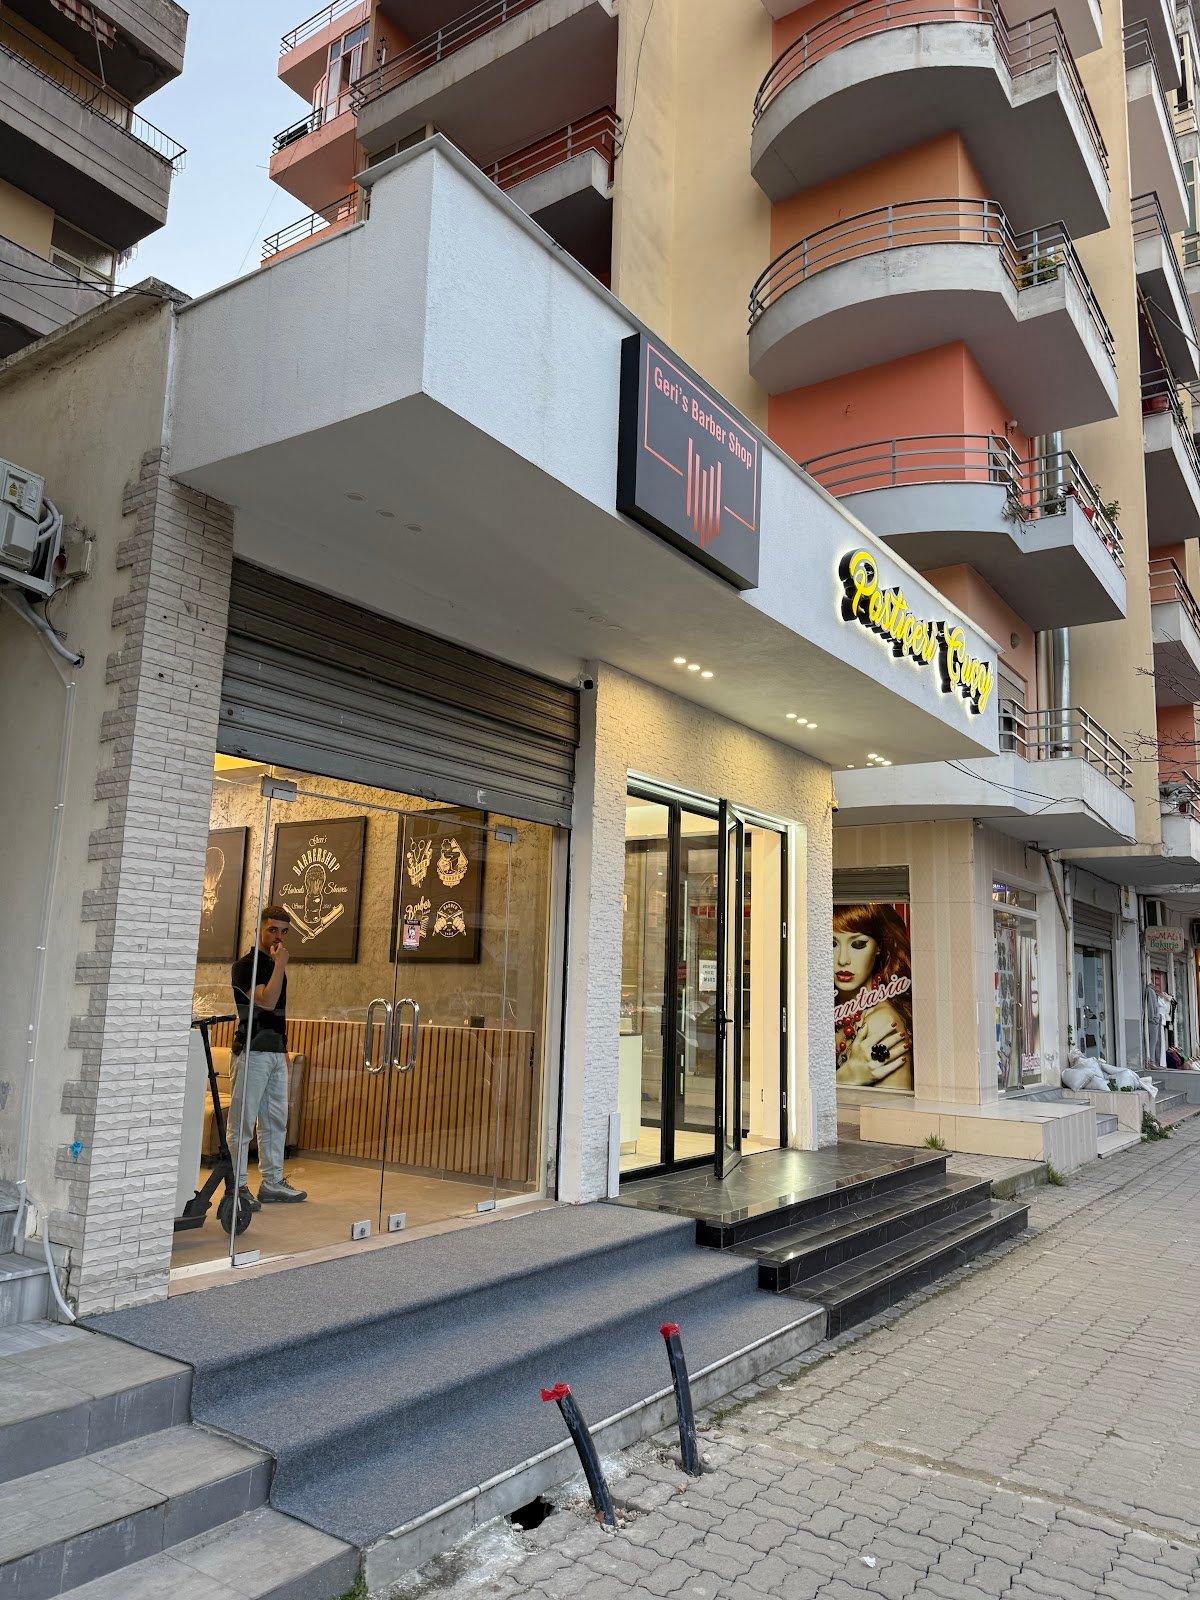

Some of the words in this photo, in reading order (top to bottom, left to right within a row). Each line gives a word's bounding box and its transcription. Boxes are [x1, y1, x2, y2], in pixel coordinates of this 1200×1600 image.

[654, 366, 689, 413] Geri's
[691, 398, 727, 445] Barber
[728, 431, 753, 470] Shop
[292, 847, 341, 876] BARBERSHOP
[834, 974, 911, 1021] antasia
